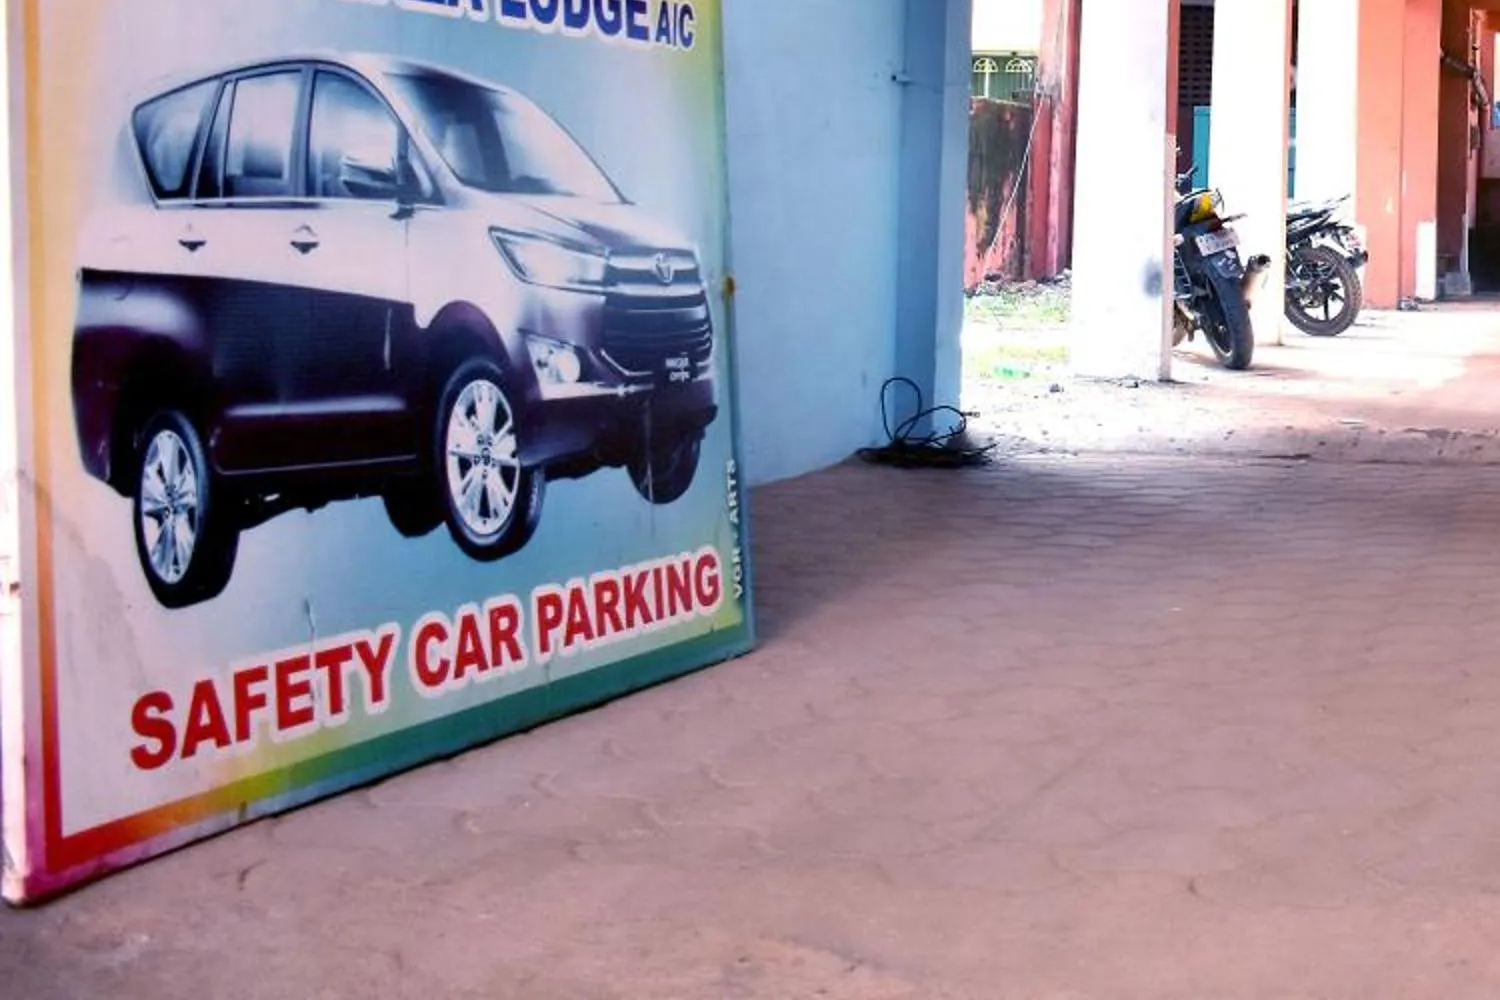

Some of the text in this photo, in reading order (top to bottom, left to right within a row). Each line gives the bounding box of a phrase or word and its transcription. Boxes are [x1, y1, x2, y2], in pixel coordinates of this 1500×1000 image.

[726, 459, 739, 524] ARTS
[130, 554, 719, 770] SAFETY CAR PARKING
